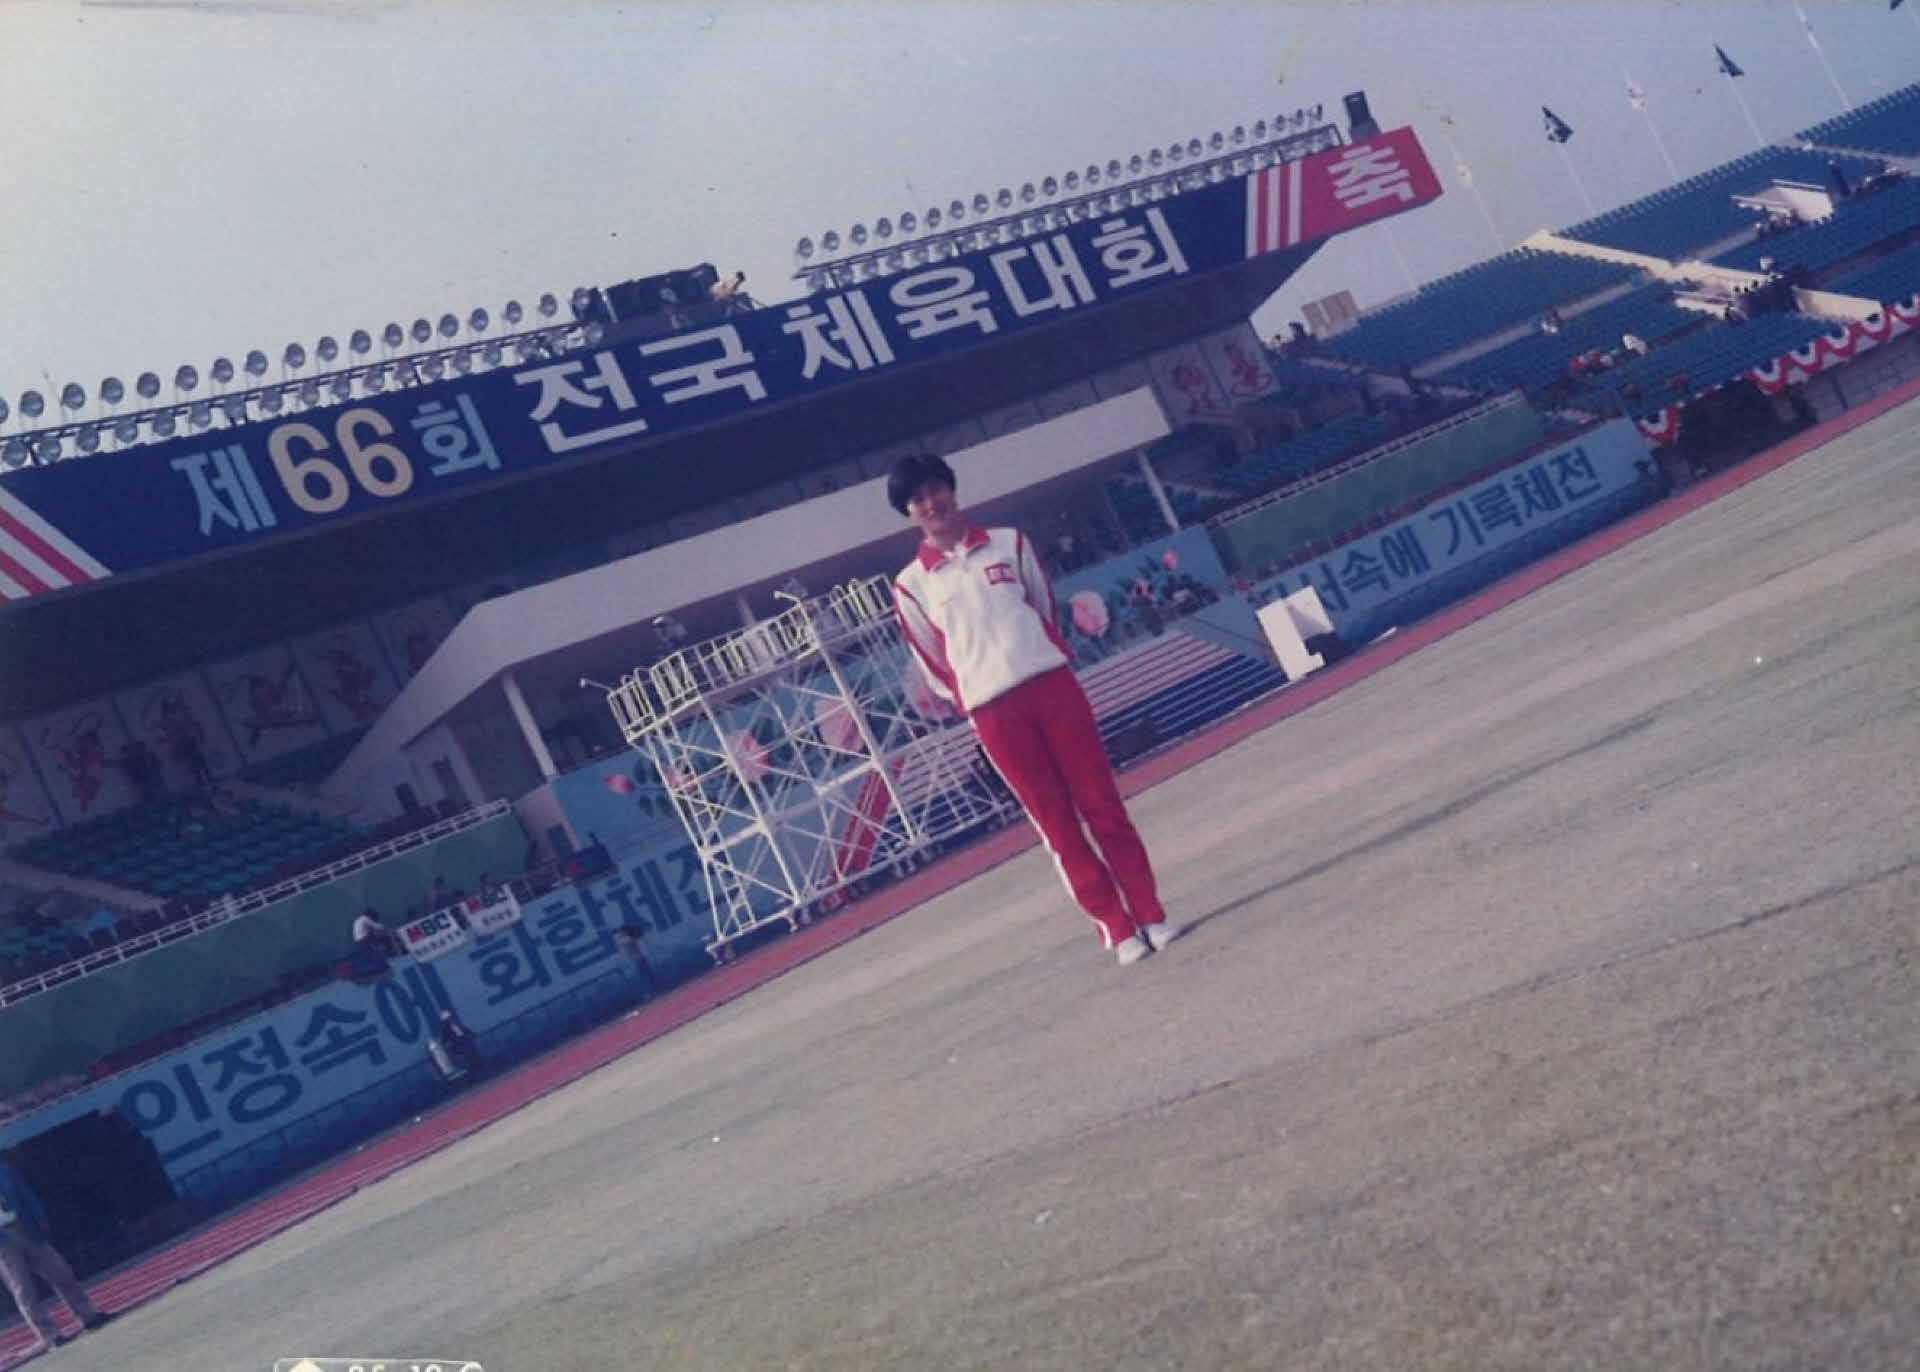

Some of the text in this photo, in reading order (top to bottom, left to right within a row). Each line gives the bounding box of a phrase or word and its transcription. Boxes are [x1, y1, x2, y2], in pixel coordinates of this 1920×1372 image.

[1327, 146, 1416, 208] 축
[171, 206, 1190, 536] 제66회 전국 체육대회
[1260, 447, 1602, 613] 서속에 기록체전
